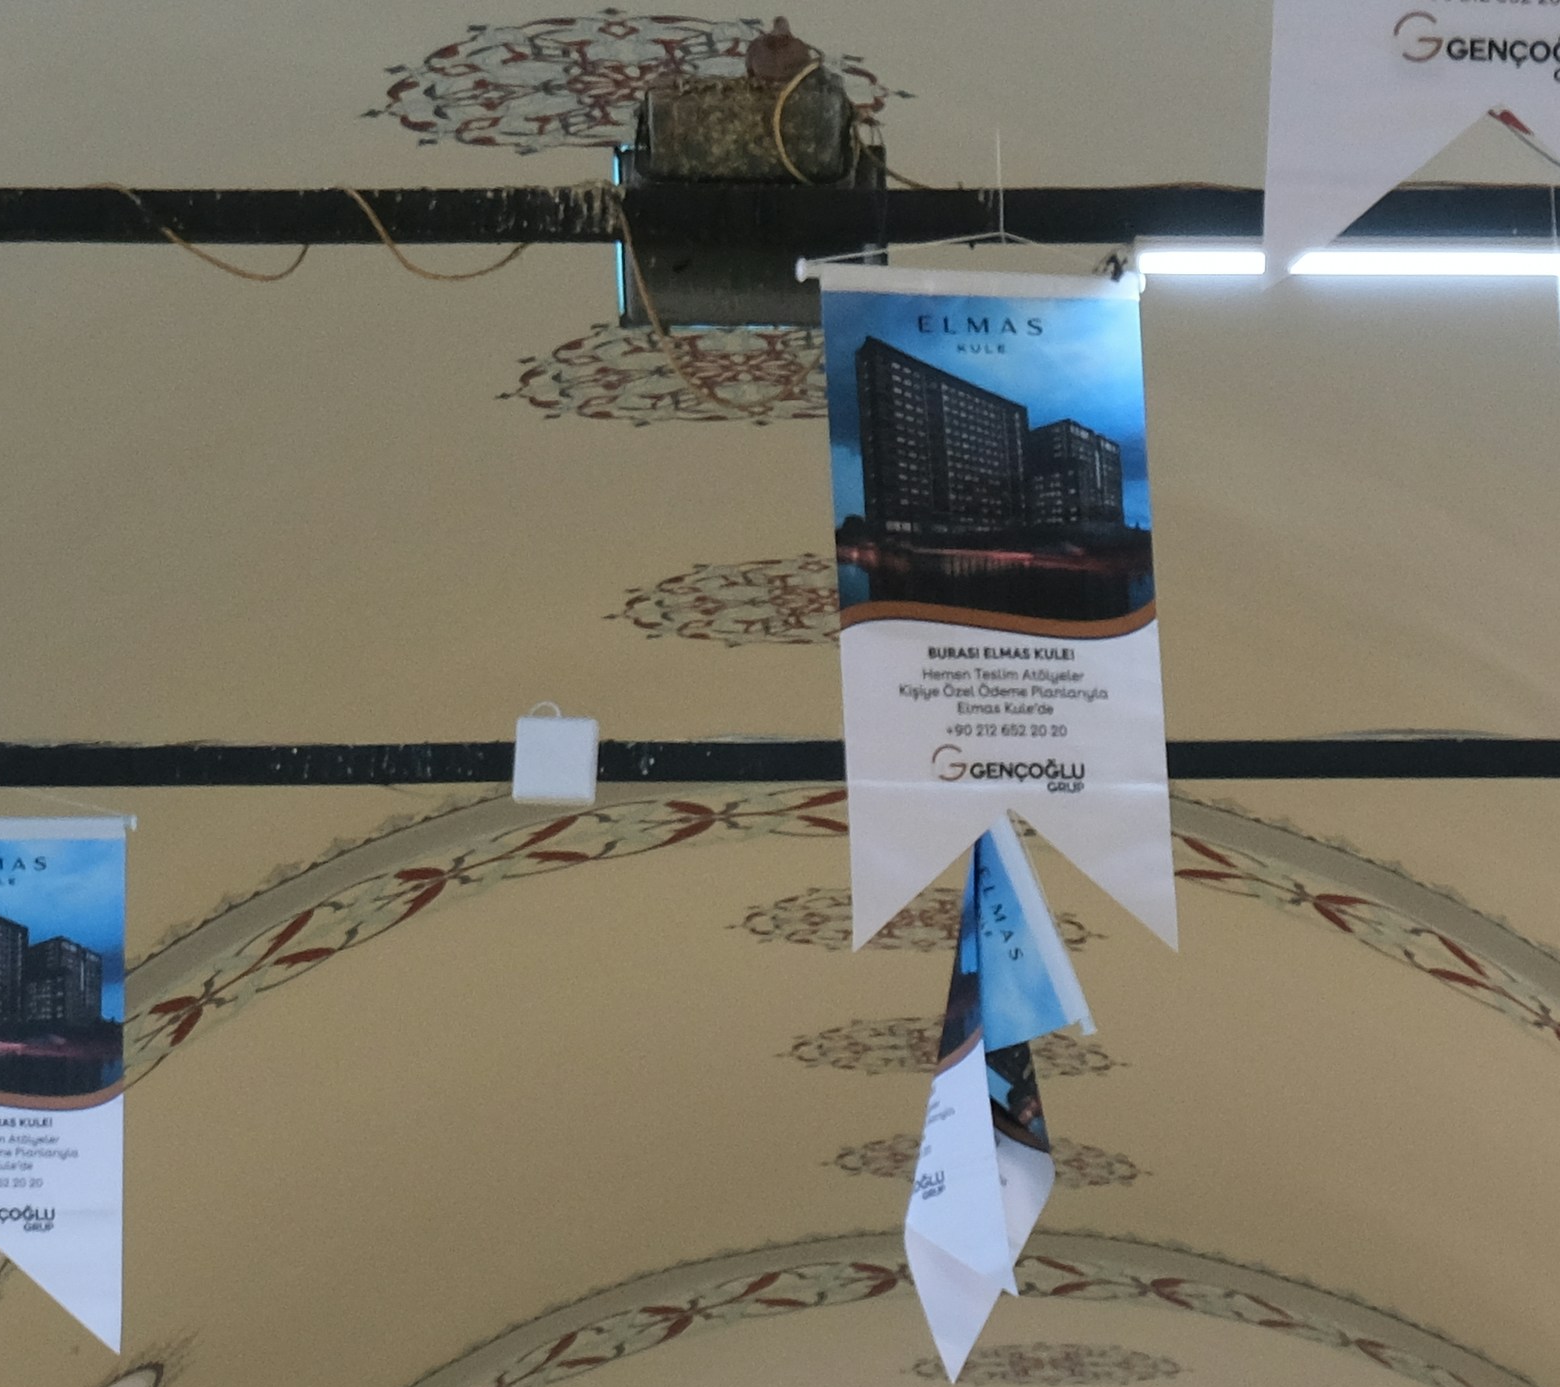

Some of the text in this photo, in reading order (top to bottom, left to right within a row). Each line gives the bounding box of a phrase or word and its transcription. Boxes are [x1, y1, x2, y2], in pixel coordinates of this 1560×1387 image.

[918, 315, 1044, 336] ELMAS
[928, 646, 981, 660] BURASI
[983, 646, 1031, 660] ELMAS
[969, 758, 1086, 783] GENÇOĞLU
